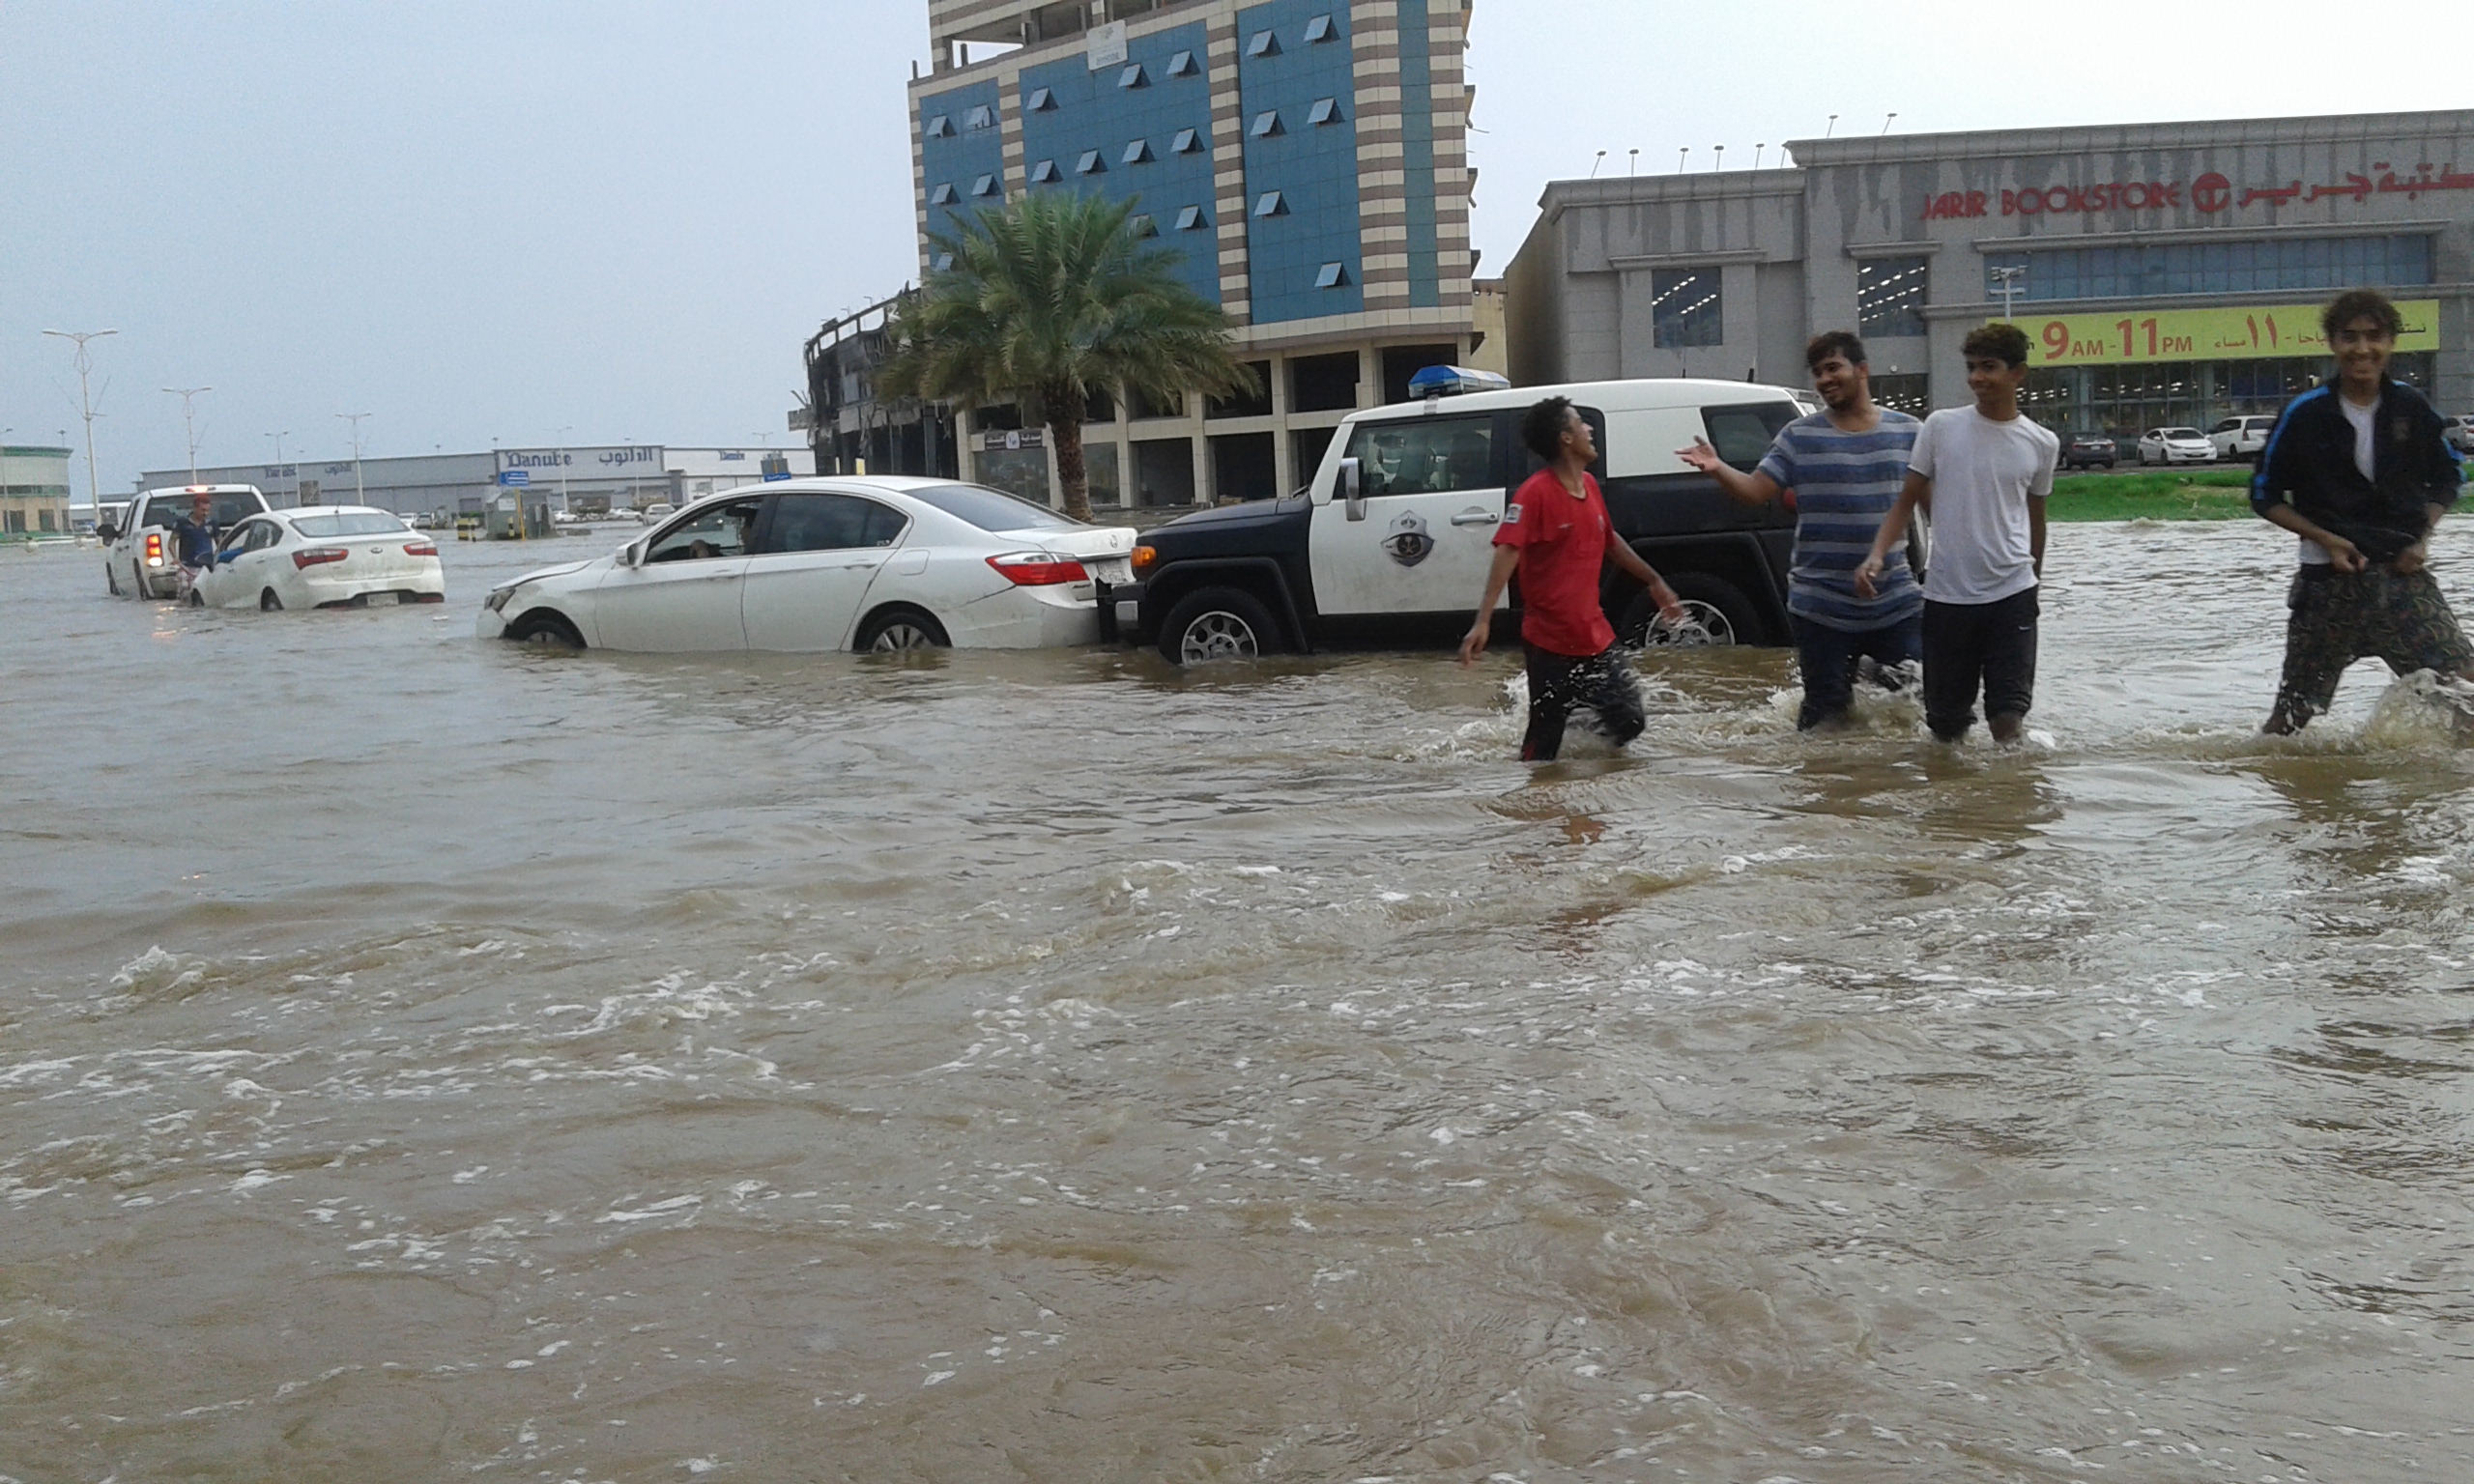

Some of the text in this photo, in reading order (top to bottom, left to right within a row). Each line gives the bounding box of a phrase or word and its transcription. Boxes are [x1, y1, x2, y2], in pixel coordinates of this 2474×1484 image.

[2237, 162, 2474, 206] كتبة جرير
[1920, 182, 2182, 220] JARIR BOOKSTORE
[505, 450, 573, 468] Danube
[598, 446, 653, 467] الدانوب
